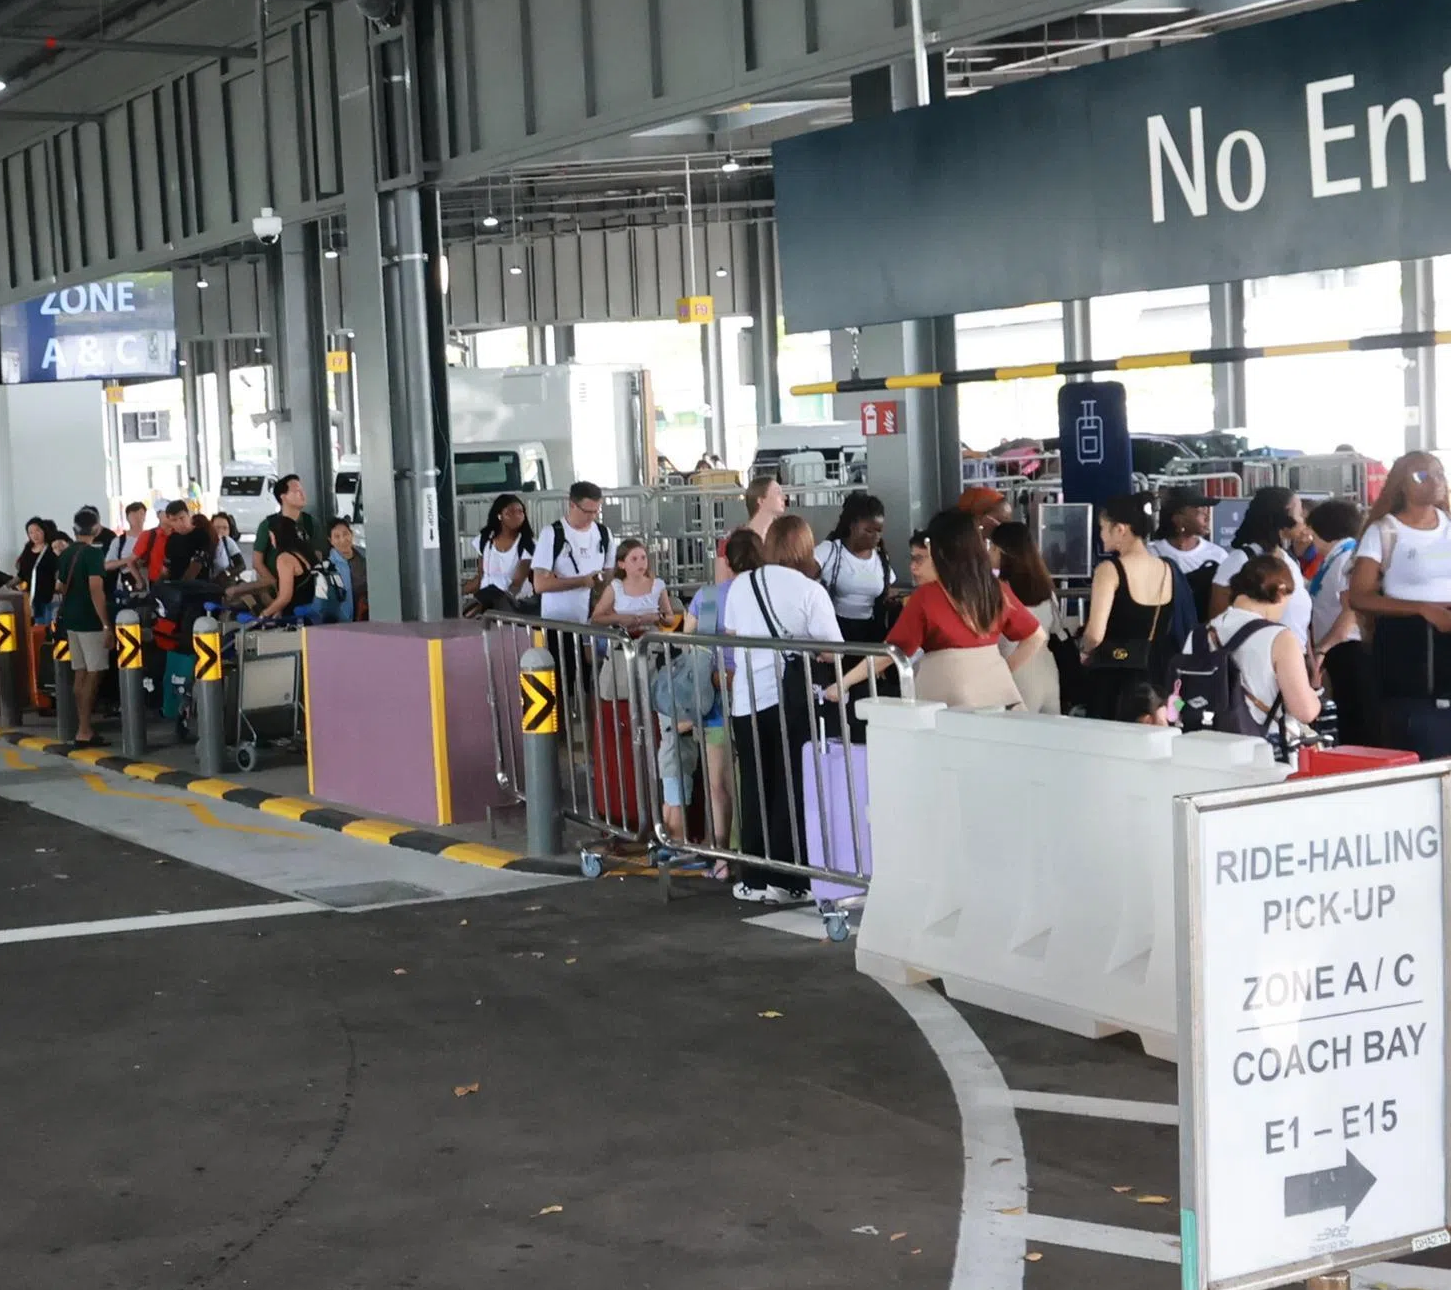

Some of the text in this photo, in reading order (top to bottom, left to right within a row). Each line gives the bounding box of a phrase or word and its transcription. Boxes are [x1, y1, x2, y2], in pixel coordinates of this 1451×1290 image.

[1146, 106, 1268, 224] No
[40, 280, 136, 315] ZONE
[41, 338, 67, 369] A
[116, 335, 138, 366] C
[1215, 825, 1439, 885] RIDE-HAILING
[1263, 883, 1396, 935] PICK-UP
[1242, 964, 1336, 1011] ZONE
[1343, 961, 1368, 997] A
[1393, 953, 1416, 988] C
[1232, 1022, 1428, 1087] COACH BAY
[1264, 1115, 1301, 1155] E1
[1342, 1099, 1399, 1140] E15
